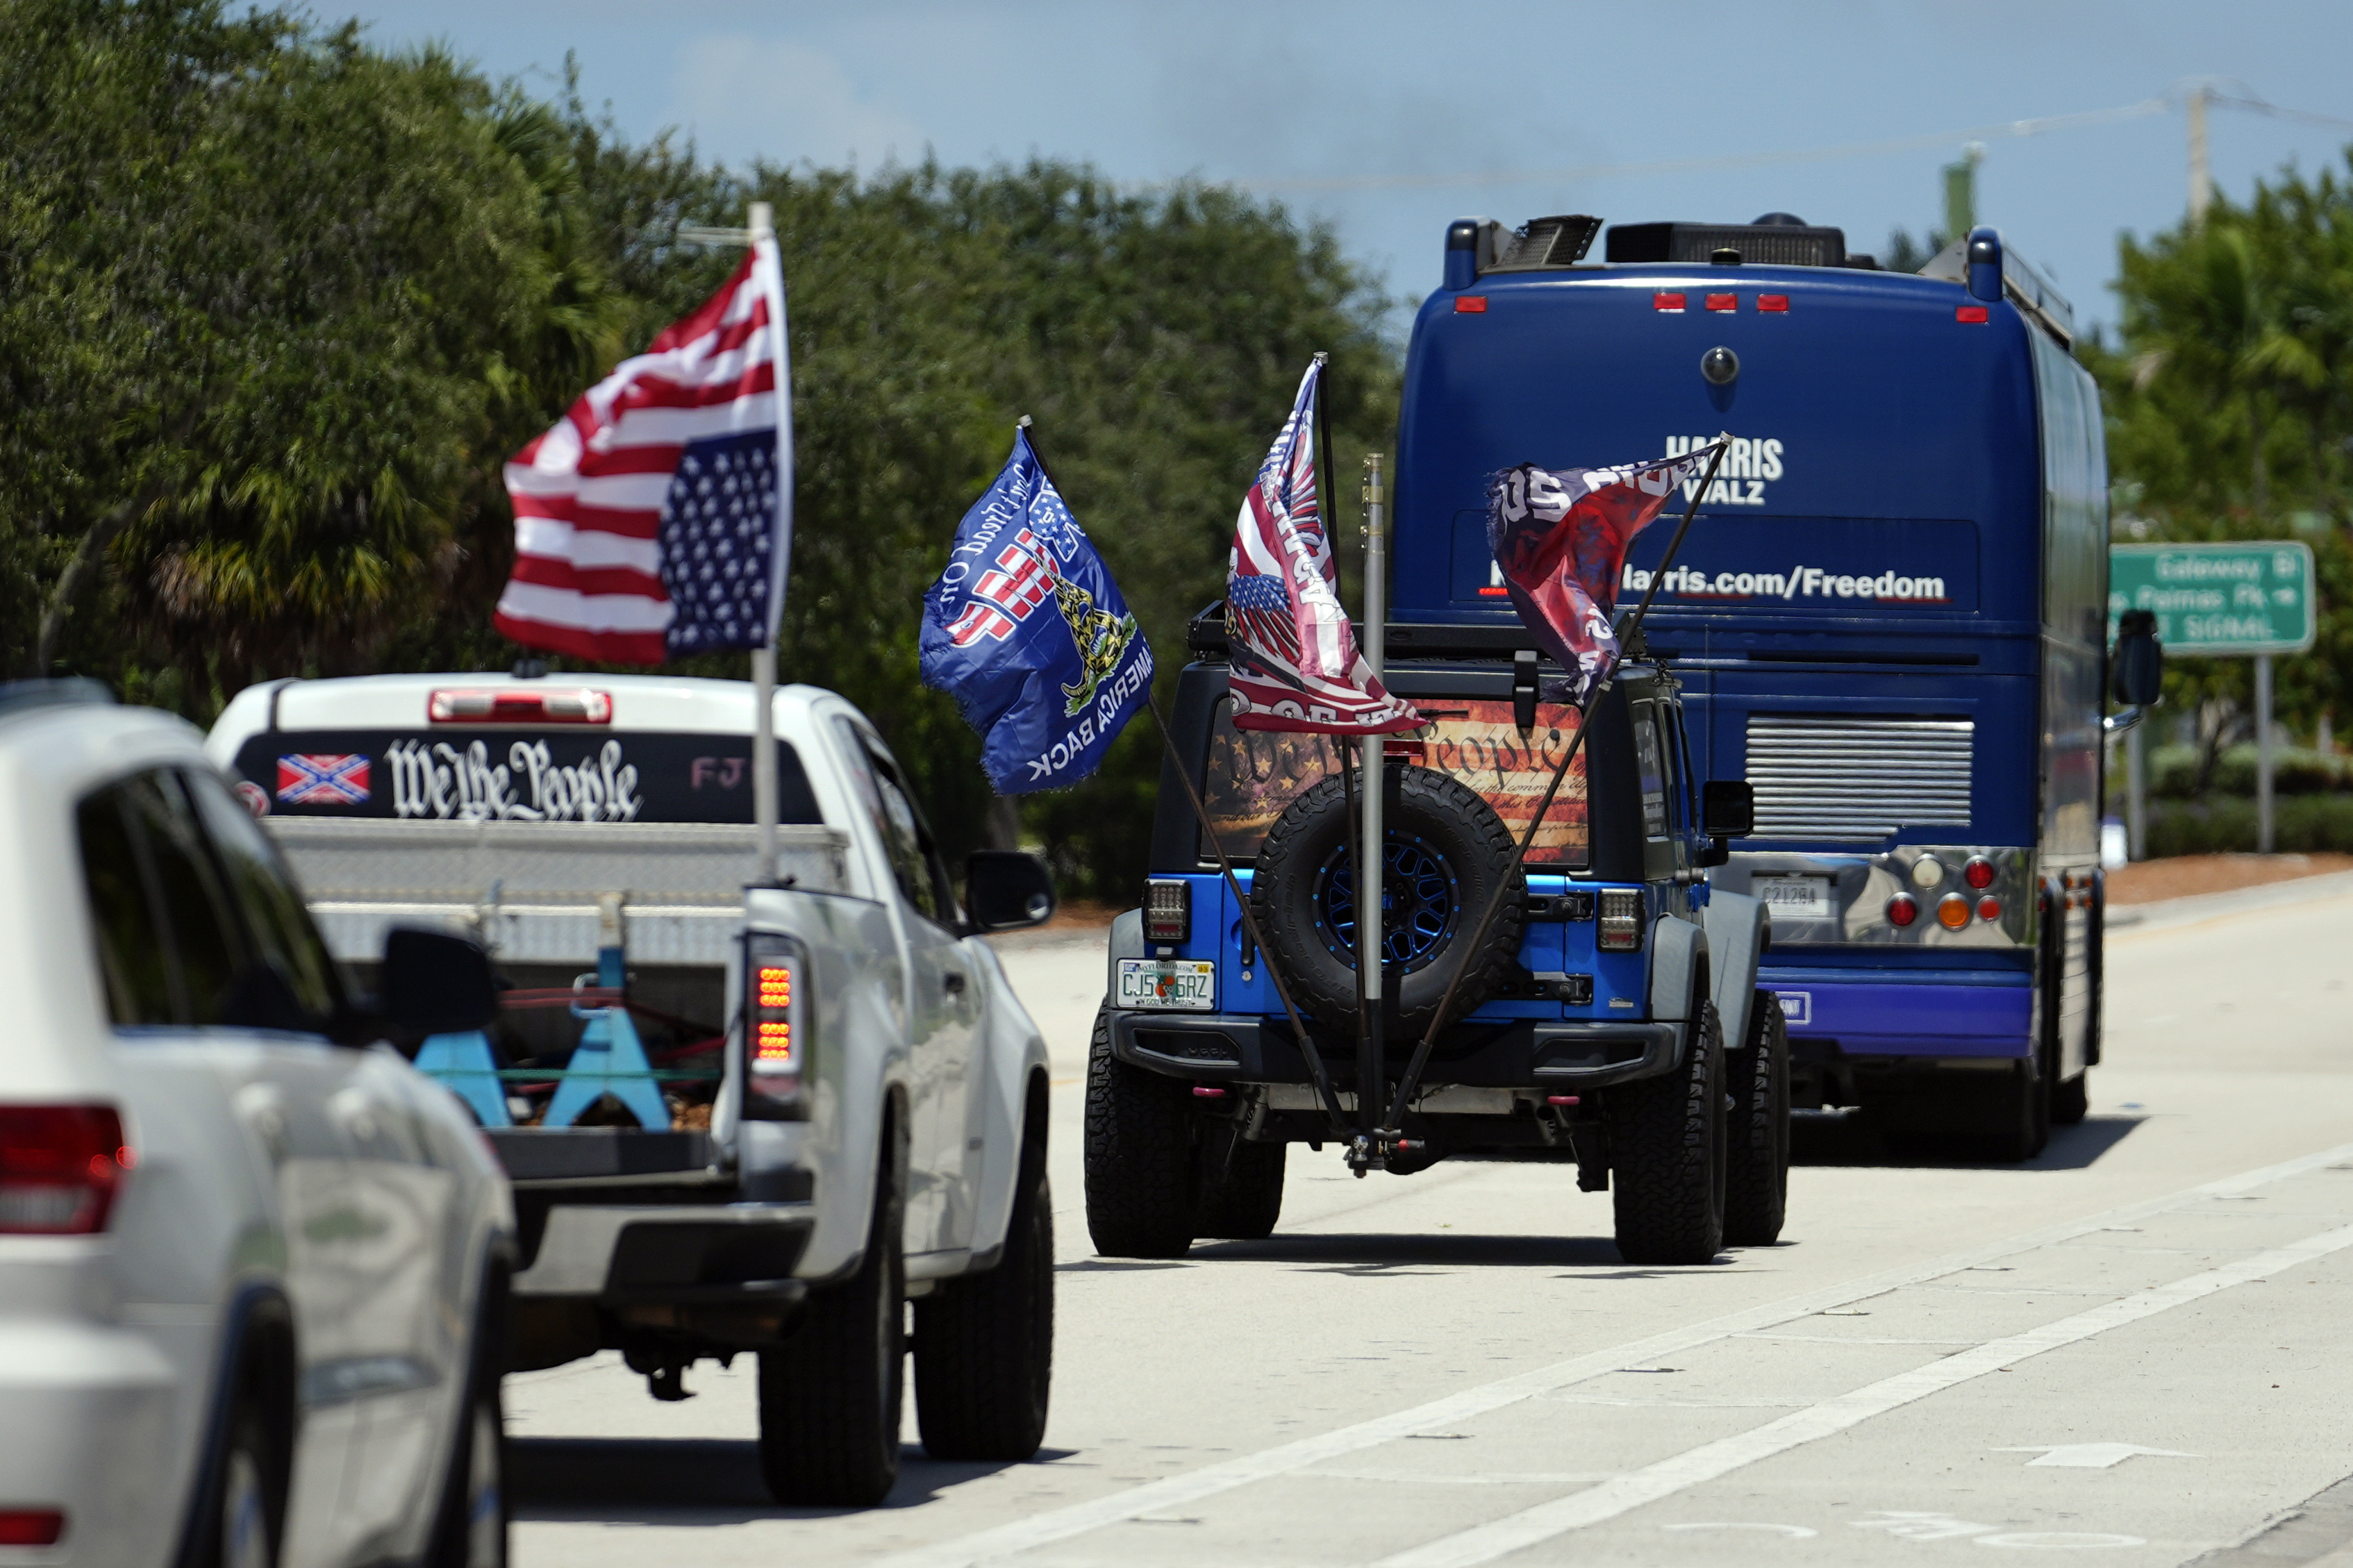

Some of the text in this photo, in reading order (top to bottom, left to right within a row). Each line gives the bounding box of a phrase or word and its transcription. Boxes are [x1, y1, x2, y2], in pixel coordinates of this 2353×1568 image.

[1682, 478, 1765, 505] WALZ
[383, 737, 459, 819] We
[501, 739, 645, 822] People
[691, 756, 750, 790] FJ
[1507, 783, 1567, 793] commn
